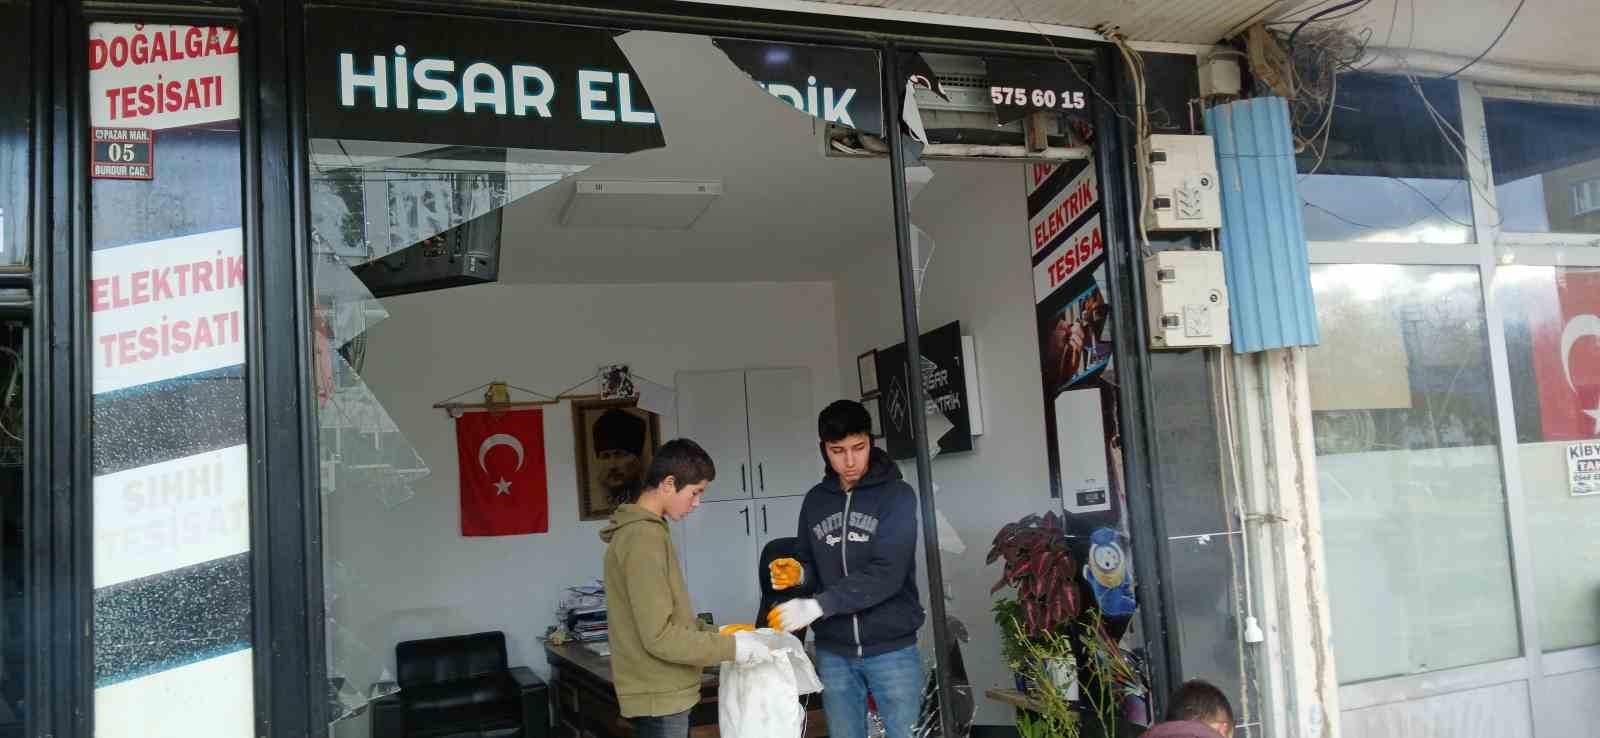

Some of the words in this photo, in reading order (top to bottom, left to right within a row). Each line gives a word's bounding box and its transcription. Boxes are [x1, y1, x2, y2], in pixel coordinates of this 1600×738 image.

[89, 23, 239, 70] DOĞALGAZ
[105, 74, 223, 120] TESİSATI
[339, 44, 555, 118] HİSAR
[990, 86, 1028, 106] 575
[1031, 89, 1056, 108] 60
[1061, 91, 1086, 110] 15
[108, 142, 135, 162] 05
[1034, 178, 1093, 250] ELEKTRİK
[91, 249, 246, 312] ELEKTRİK
[99, 310, 240, 368] TESİSATI
